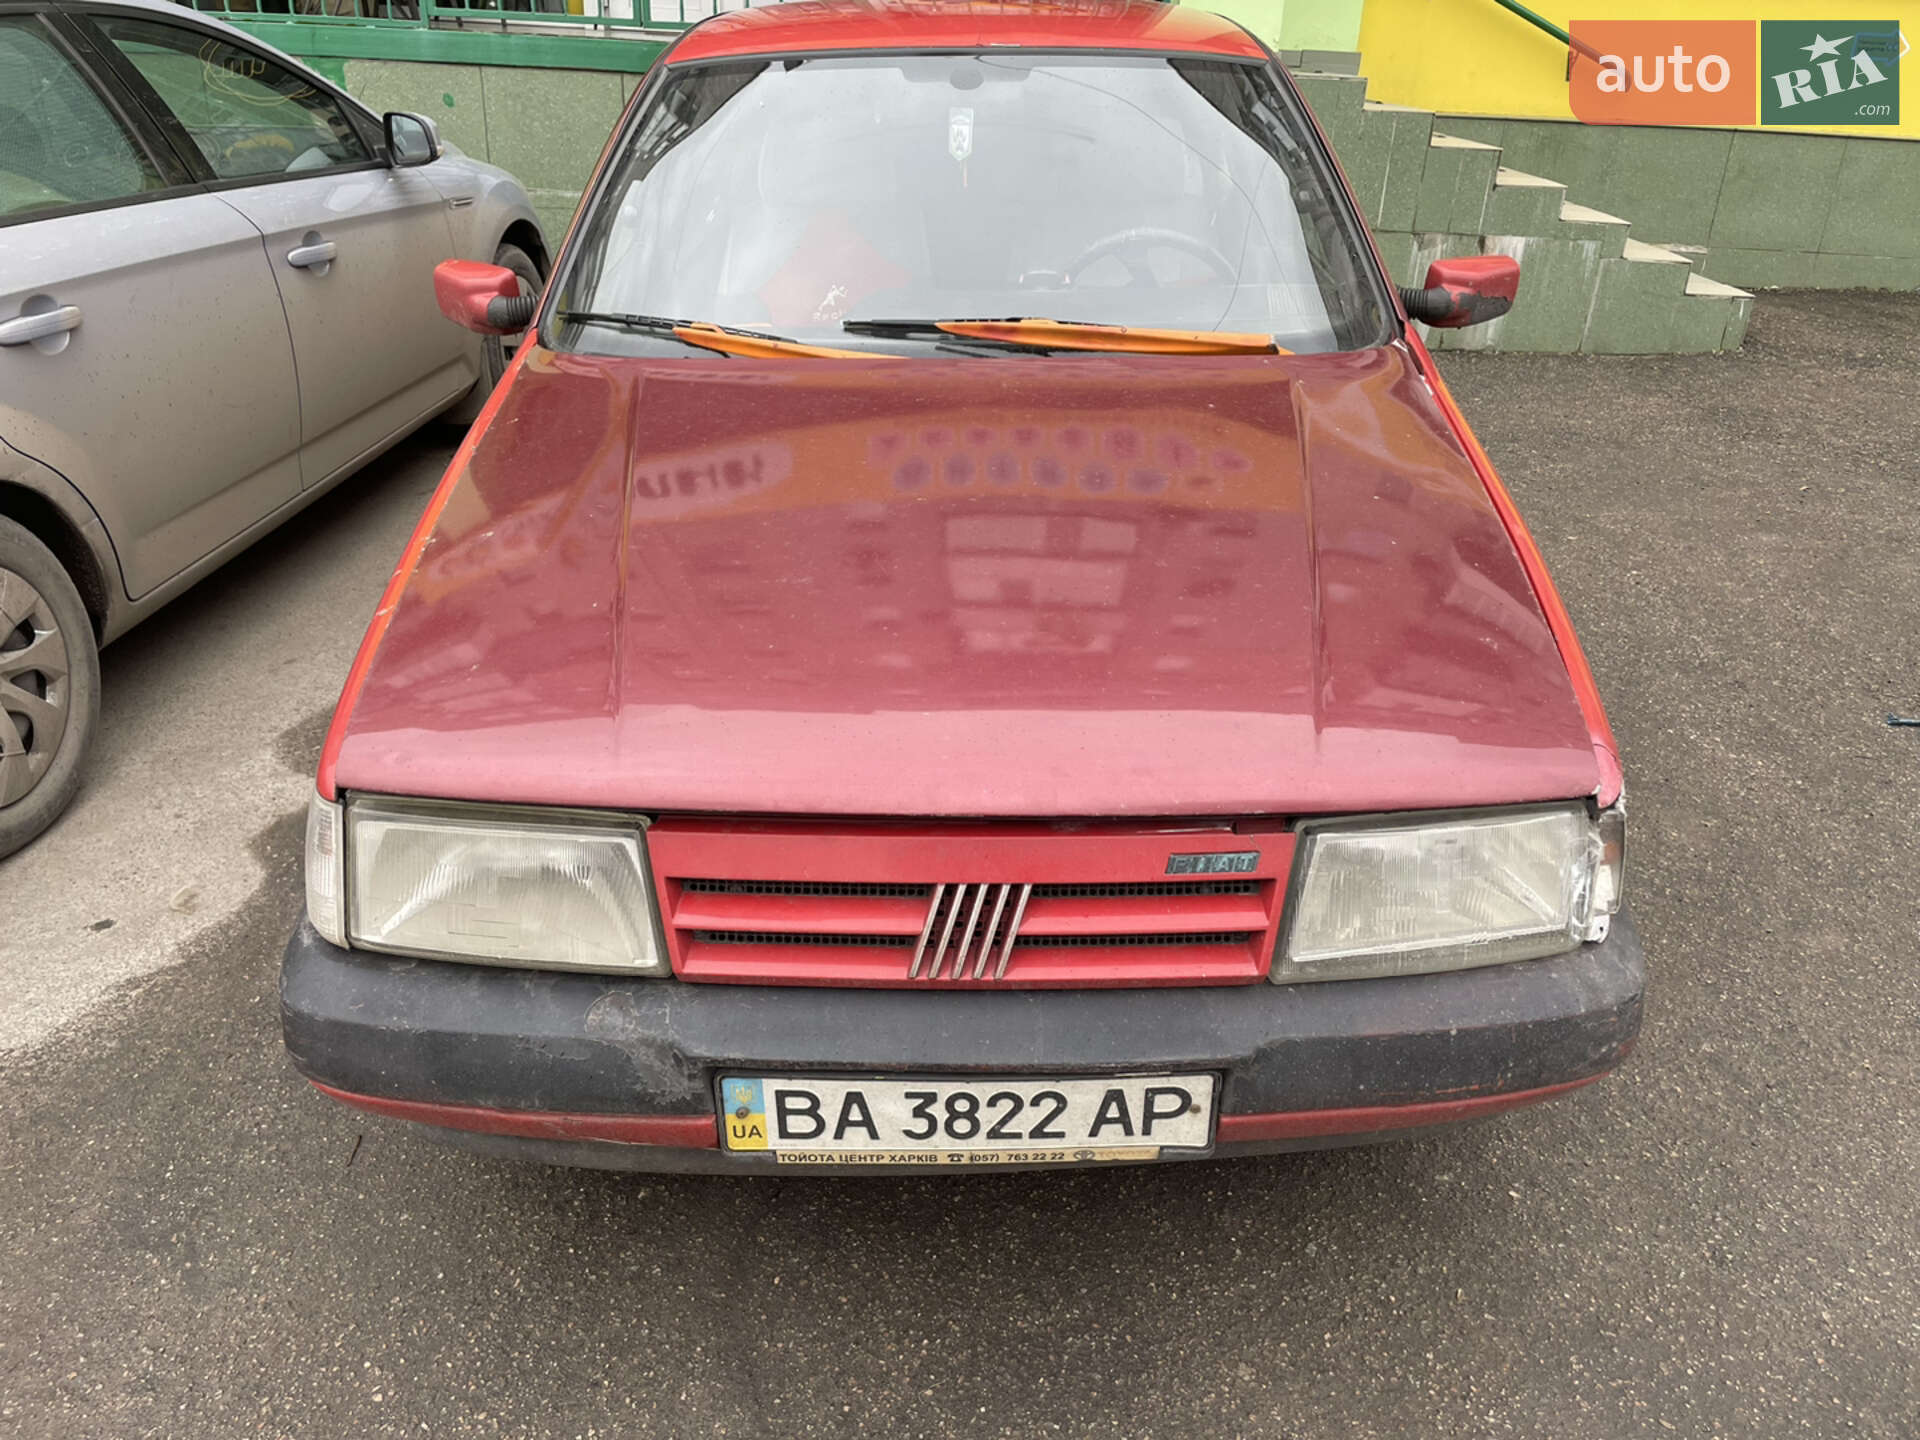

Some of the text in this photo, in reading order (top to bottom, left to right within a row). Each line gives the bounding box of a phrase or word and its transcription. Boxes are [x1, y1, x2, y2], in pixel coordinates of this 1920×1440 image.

[1171, 854, 1257, 873] FIAT
[775, 1087, 1193, 1140] BA 3822 AP
[733, 1125, 763, 1139] UA
[779, 1151, 1065, 1164] ТОЙОТА ЦЕНТР ХАРКІВ (057) 763 22 22
